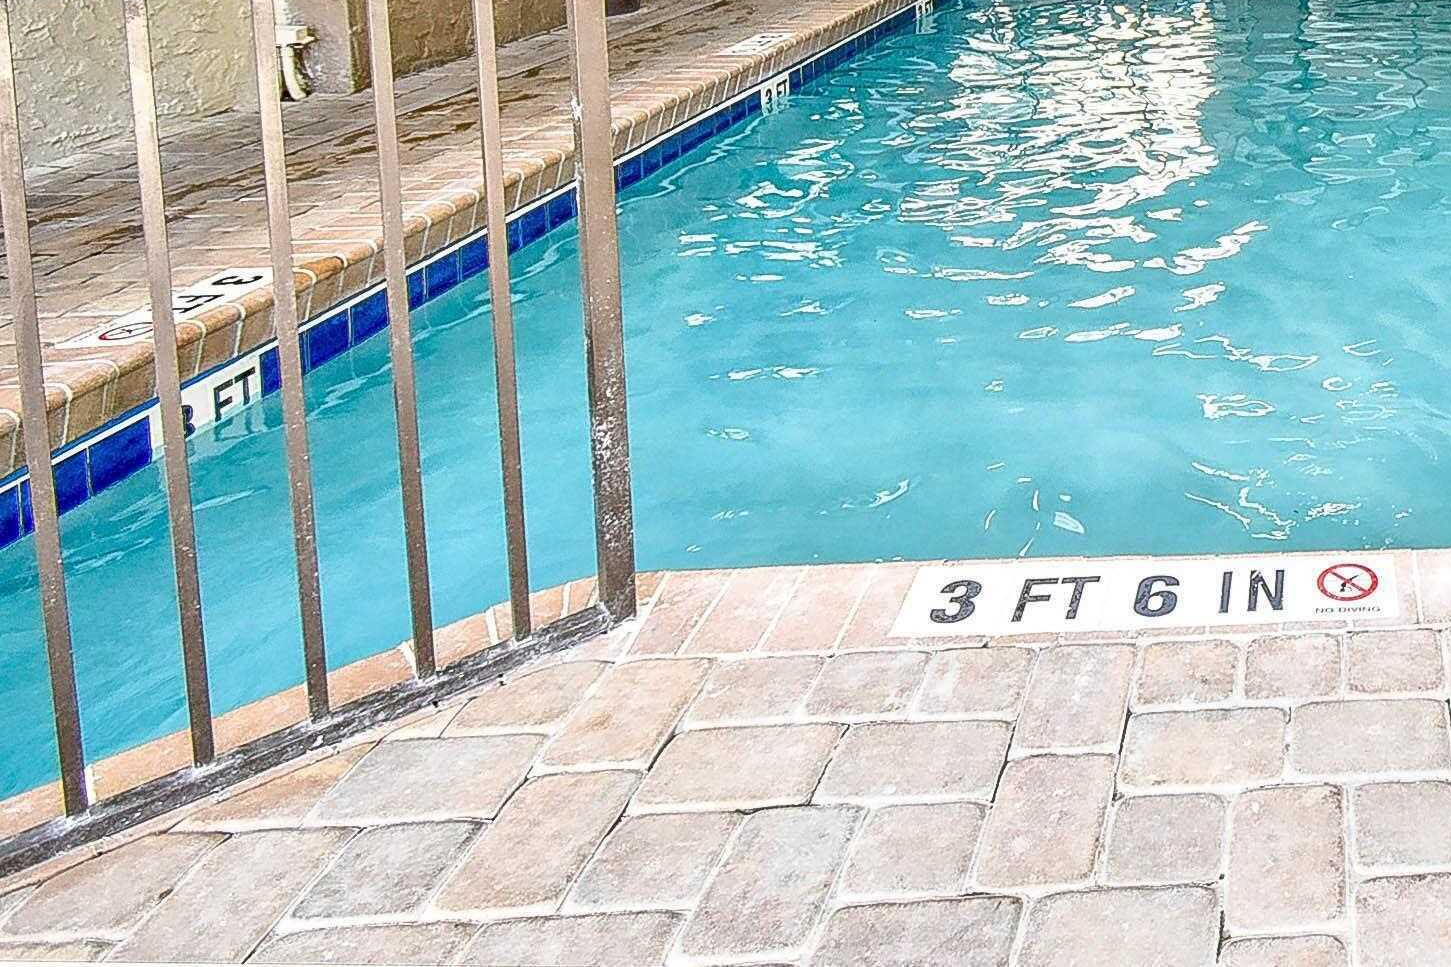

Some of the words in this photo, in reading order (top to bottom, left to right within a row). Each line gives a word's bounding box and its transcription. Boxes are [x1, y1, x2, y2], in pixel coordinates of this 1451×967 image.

[766, 88, 773, 105] 3
[776, 79, 788, 97] FT
[211, 275, 263, 285] 3
[213, 366, 256, 423] FT
[929, 579, 983, 624] 3
[1011, 575, 1102, 623] FT
[1133, 574, 1181, 618] 6
[1218, 568, 1286, 614] IN
[1338, 605, 1382, 614] DIVING
